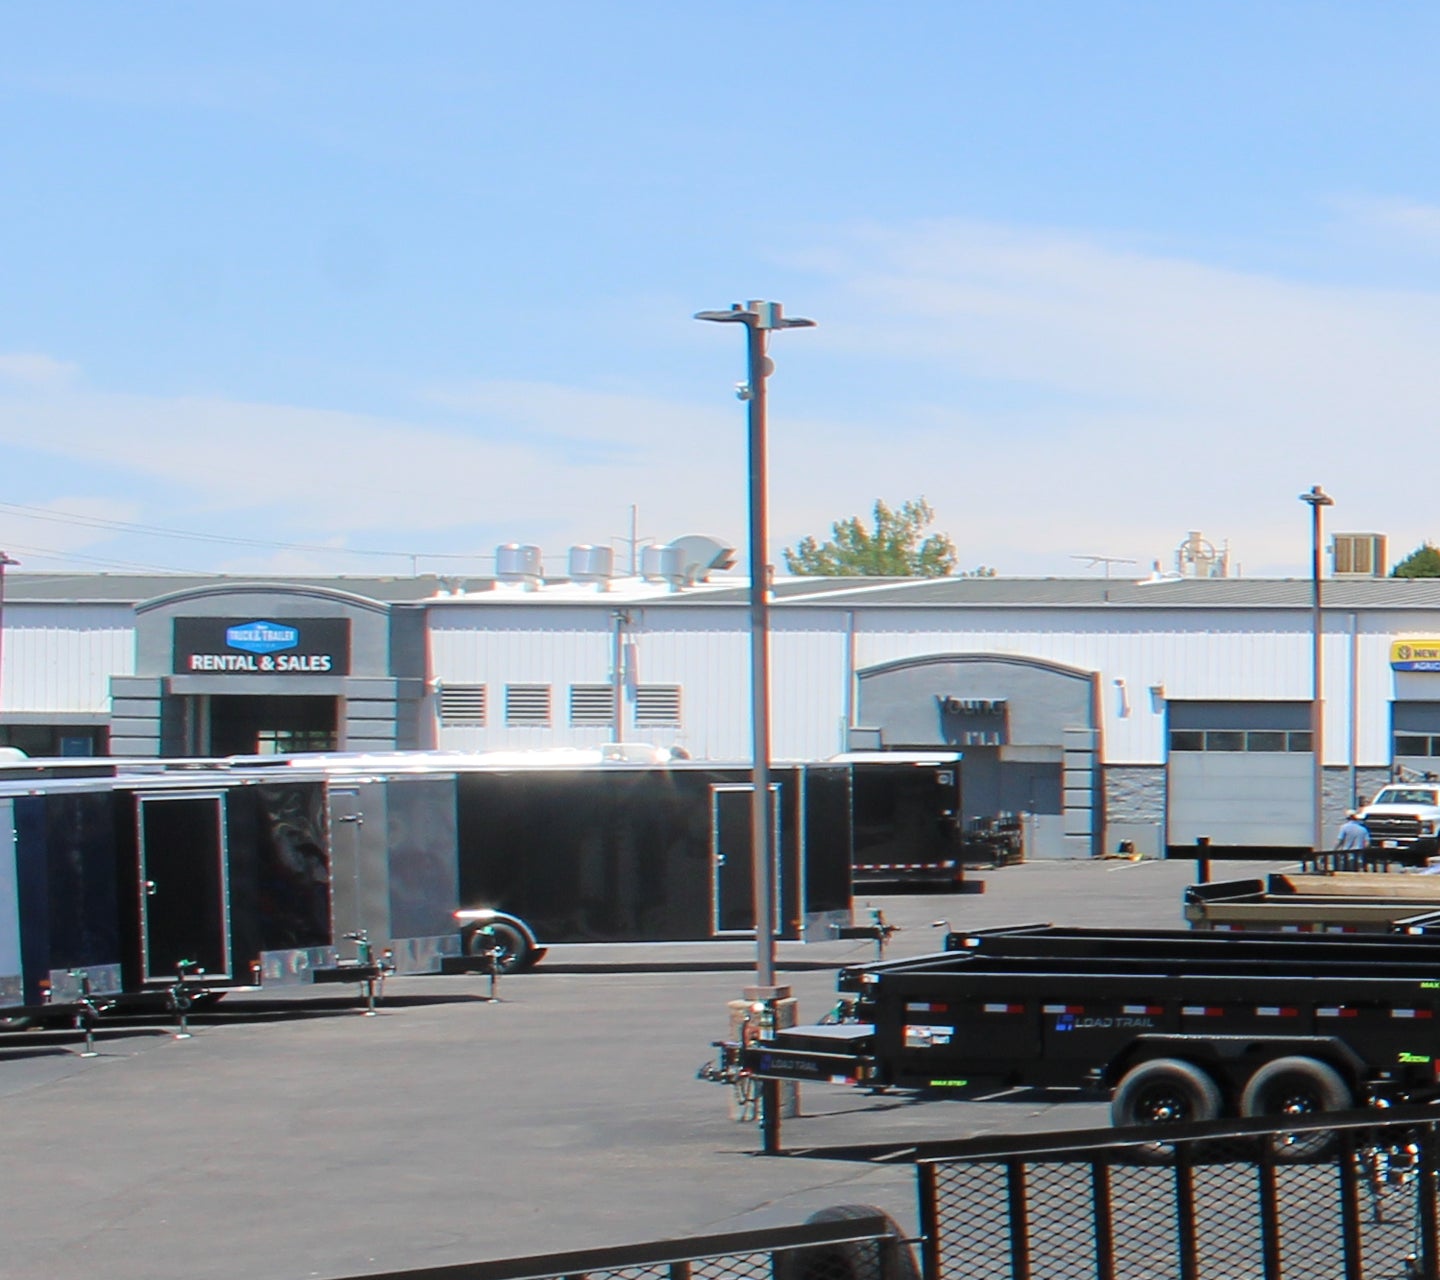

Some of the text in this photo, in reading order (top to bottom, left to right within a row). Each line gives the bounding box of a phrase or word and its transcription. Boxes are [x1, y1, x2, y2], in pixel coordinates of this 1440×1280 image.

[1413, 649, 1437, 659] NEW
[190, 654, 331, 671] RENTAL & SALES
[1075, 1018, 1155, 1028] LOAD TRAIL
